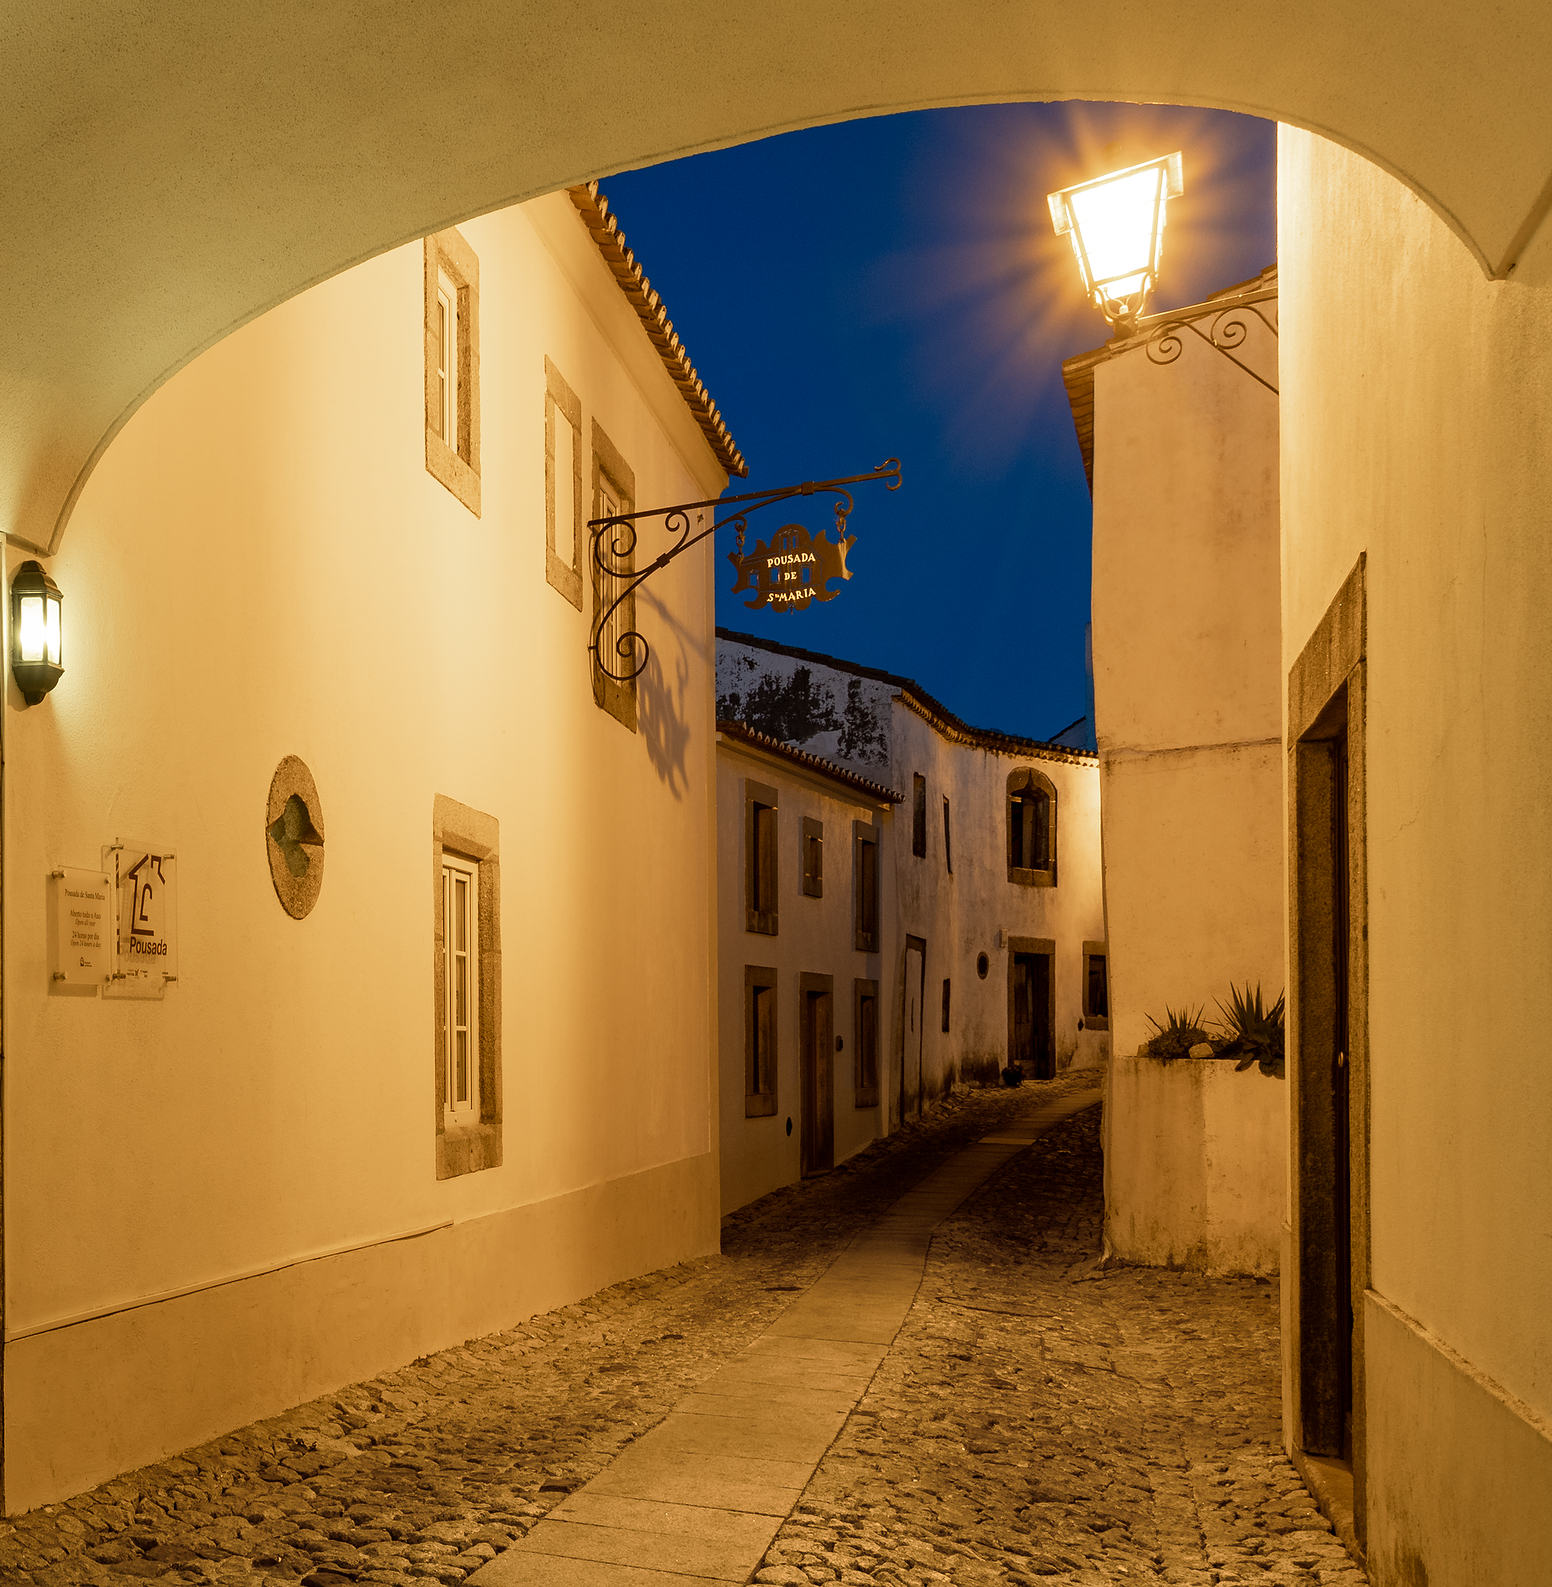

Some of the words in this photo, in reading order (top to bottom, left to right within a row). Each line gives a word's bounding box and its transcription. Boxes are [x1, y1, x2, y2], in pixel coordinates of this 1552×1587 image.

[767, 552, 816, 568] POUSADA
[784, 571, 797, 580] DE
[778, 588, 816, 602] MARIA
[65, 889, 80, 898] Pousada
[80, 890, 84, 898] de
[85, 891, 94, 899] Santa
[95, 892, 105, 900] Maria
[130, 936, 168, 955] Pousada
